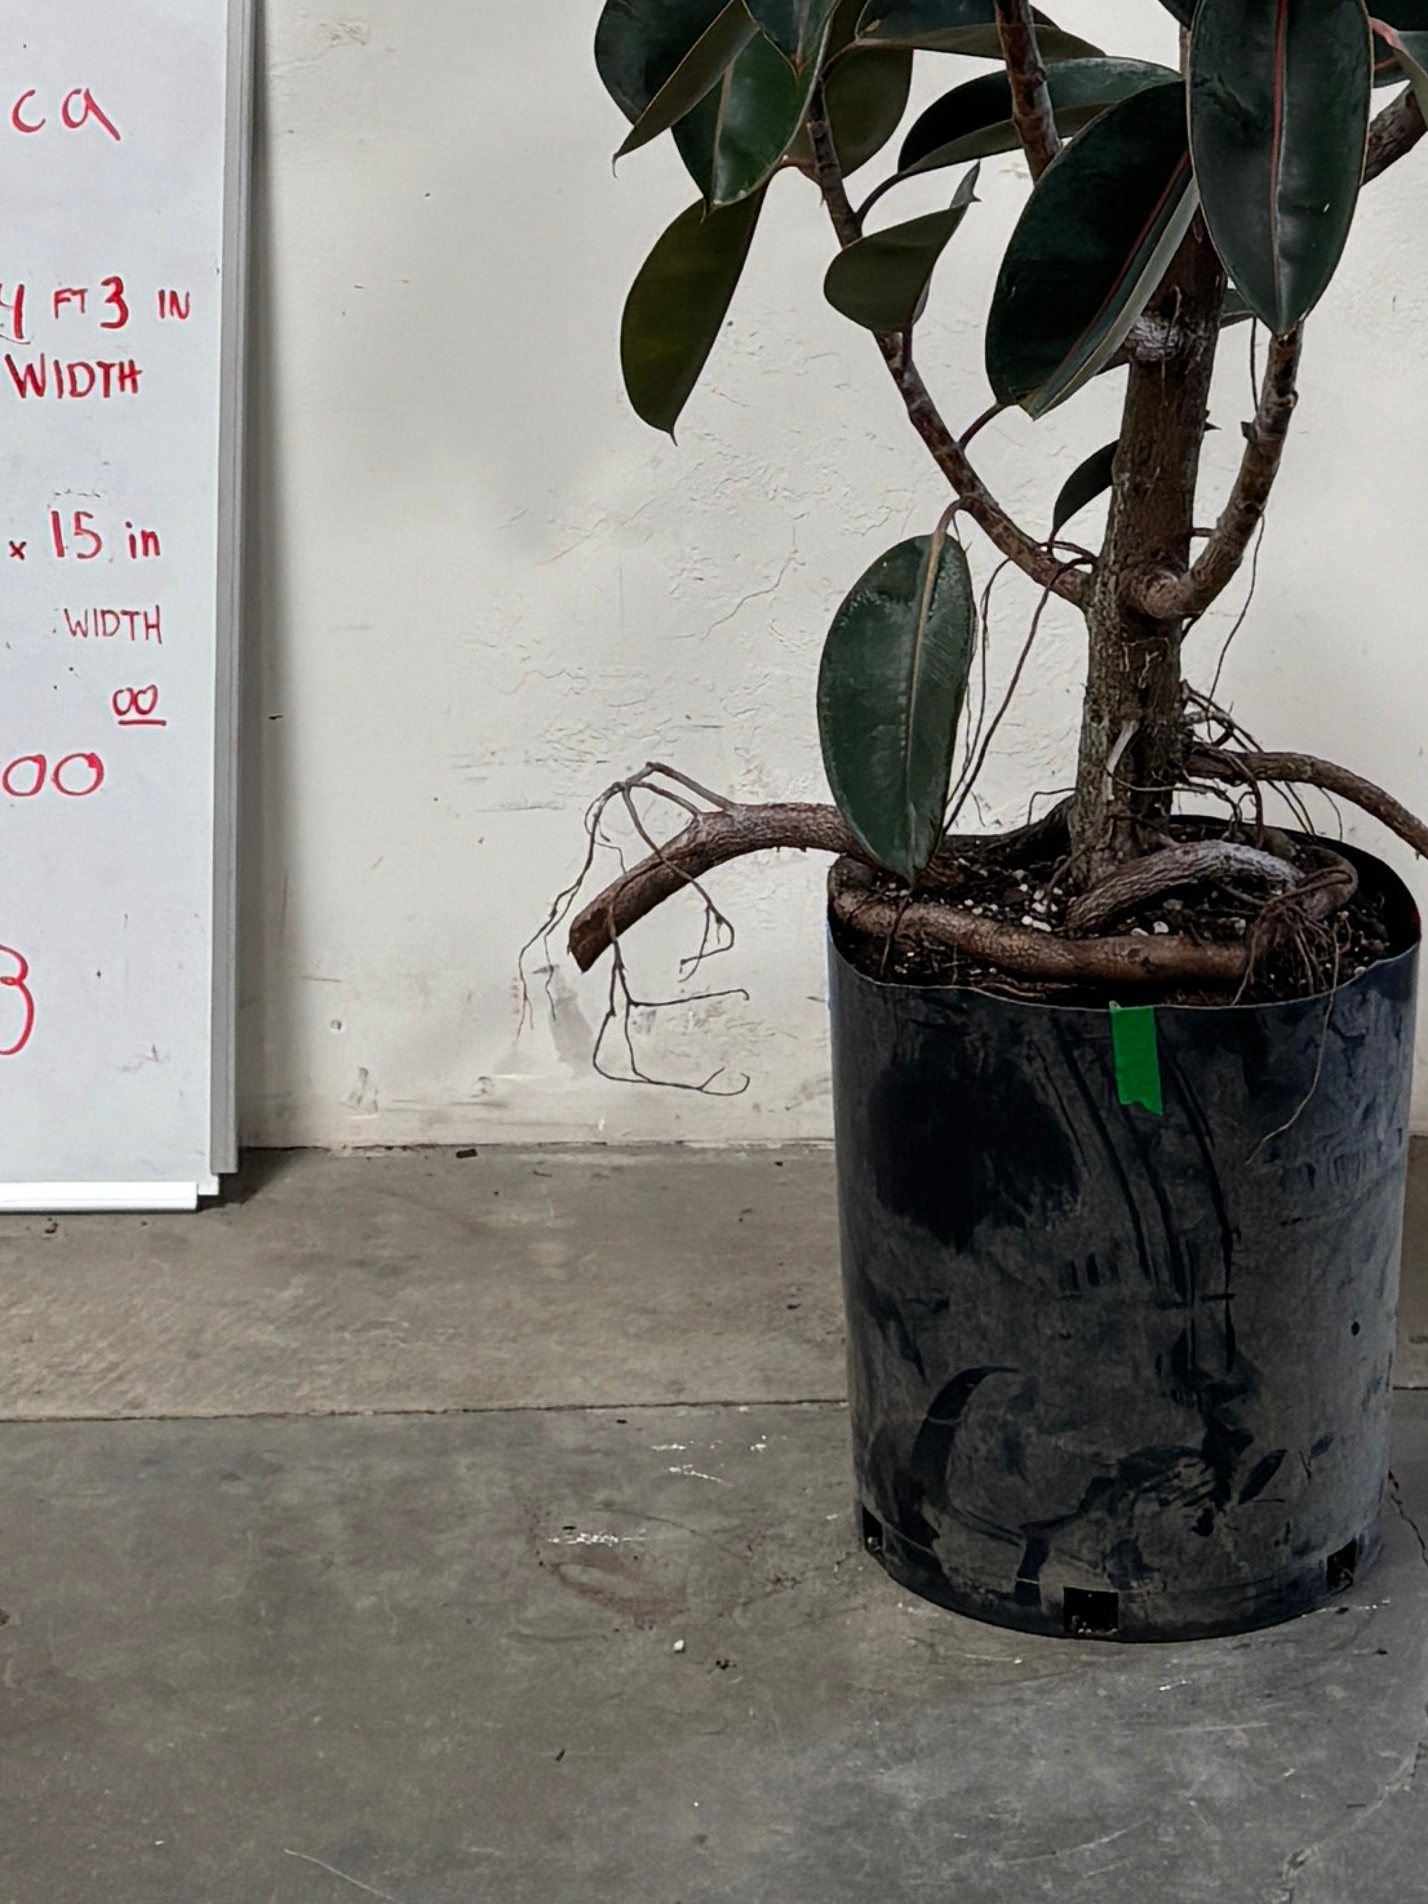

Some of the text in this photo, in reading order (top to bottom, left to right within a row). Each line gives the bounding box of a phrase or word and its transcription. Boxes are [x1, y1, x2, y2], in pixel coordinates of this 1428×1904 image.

[53, 288, 89, 320] FT
[100, 275, 130, 330] 3
[158, 289, 191, 321] IN
[4, 352, 144, 399] WIDTH
[49, 510, 103, 560] 15
[124, 521, 162, 559] in
[63, 603, 163, 645] WIDTH
